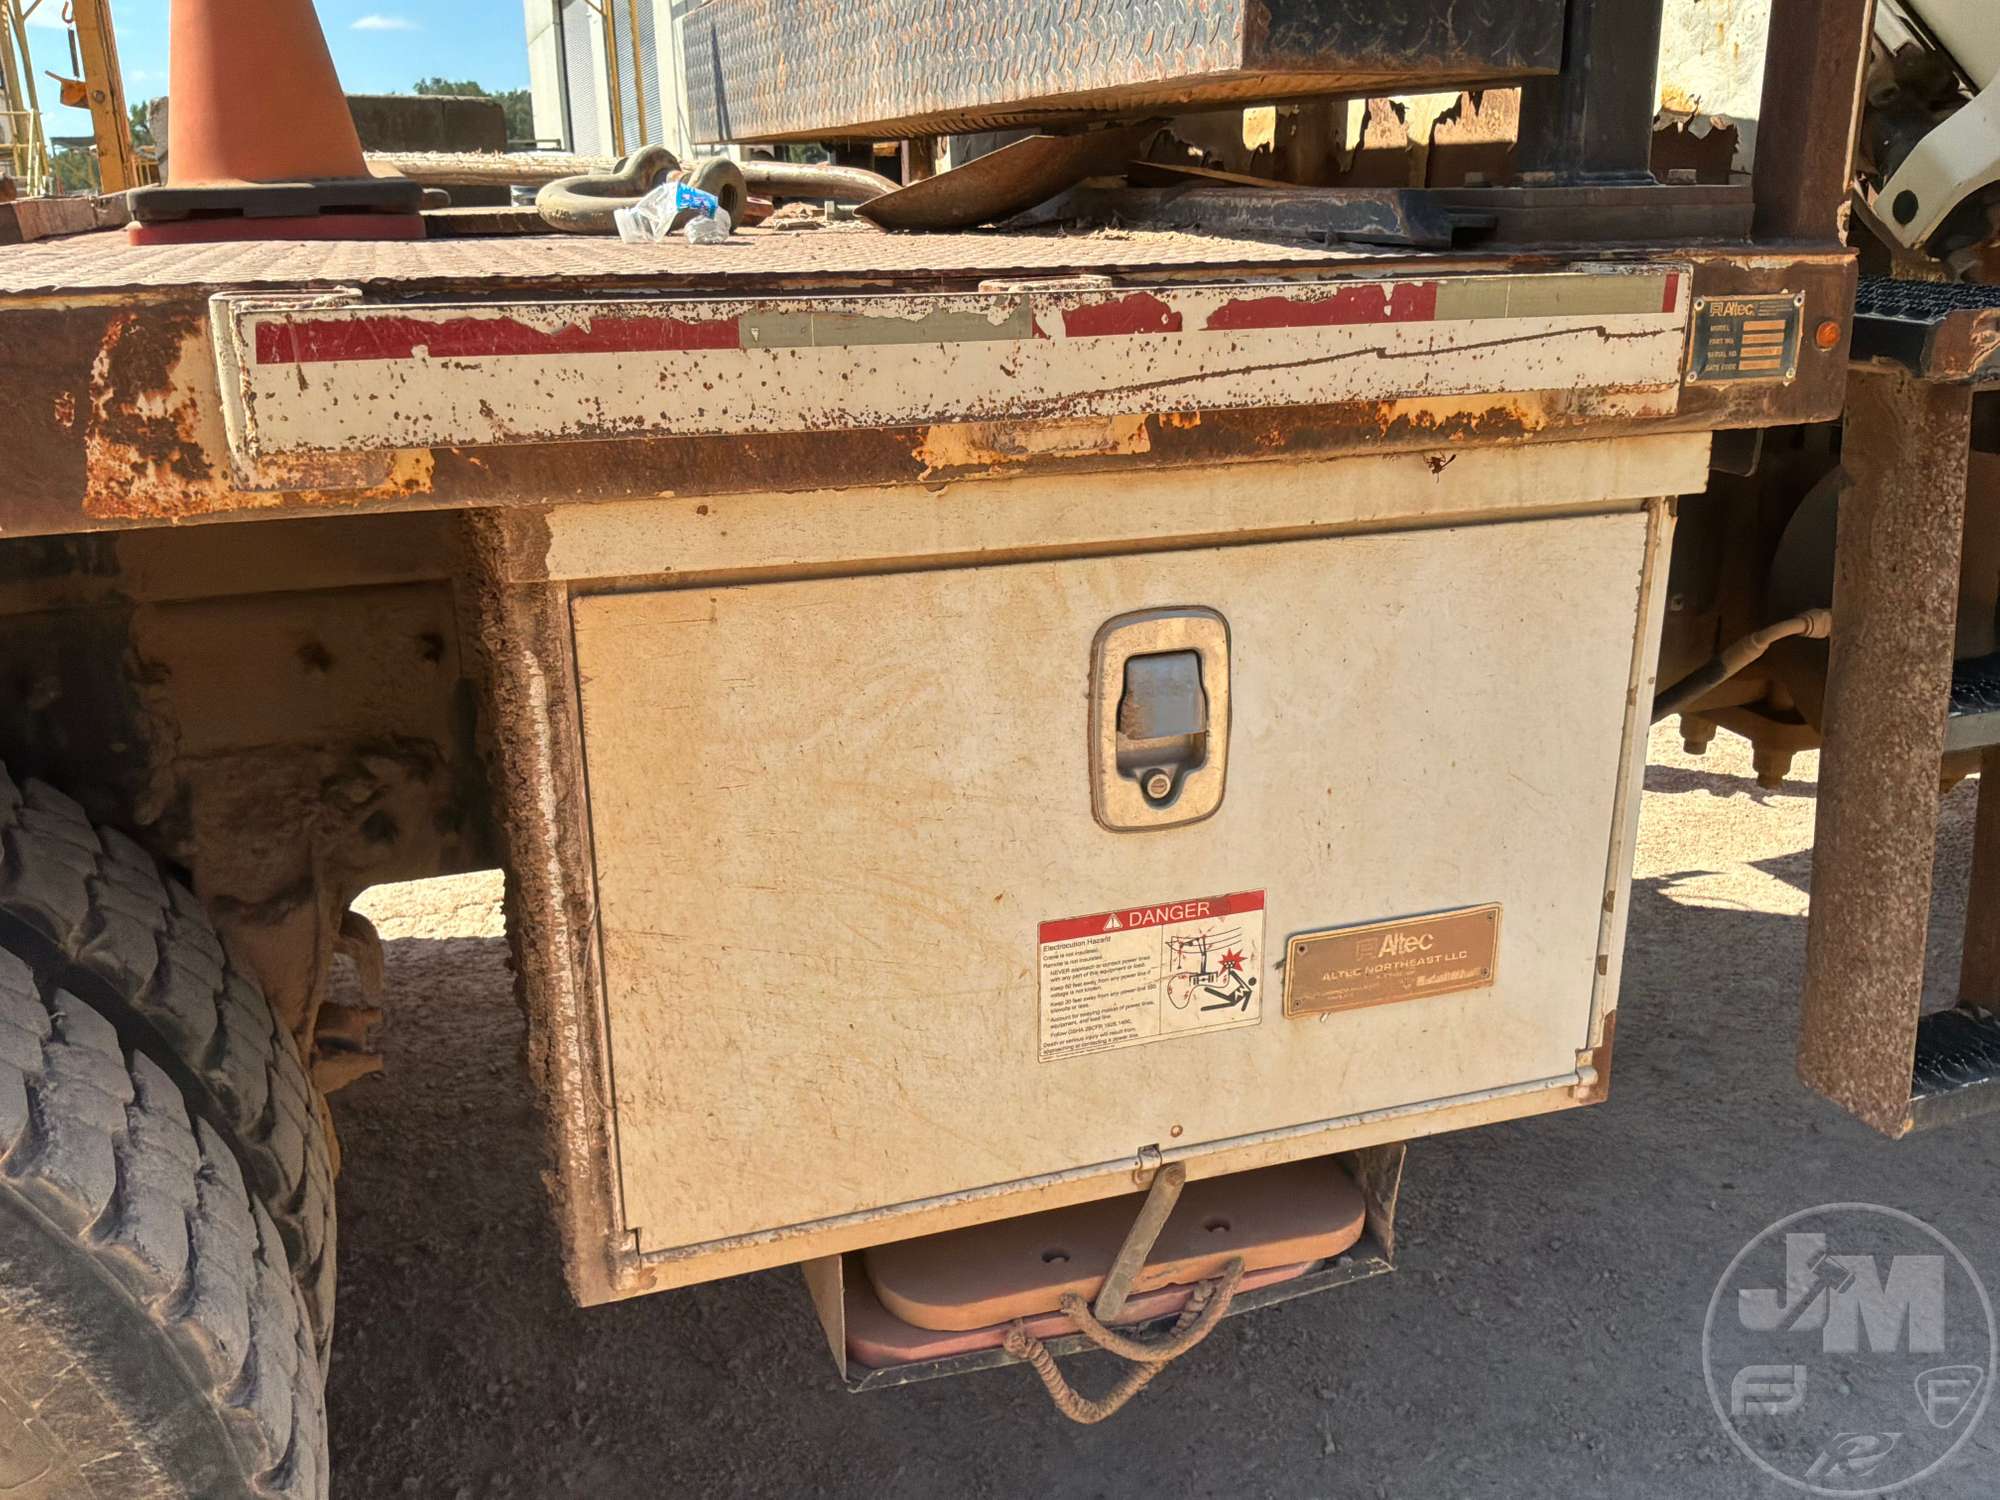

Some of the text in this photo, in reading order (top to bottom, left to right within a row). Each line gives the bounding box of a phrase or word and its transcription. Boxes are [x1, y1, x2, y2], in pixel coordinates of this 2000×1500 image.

[1723, 302, 1754, 316] Altec
[1129, 902, 1210, 927] DANGER
[1042, 936, 1111, 951] Electrocution Hazard
[1378, 932, 1434, 958] Altec
[1364, 954, 1442, 975] NORTHEAST
[1444, 950, 1468, 962] LLC
